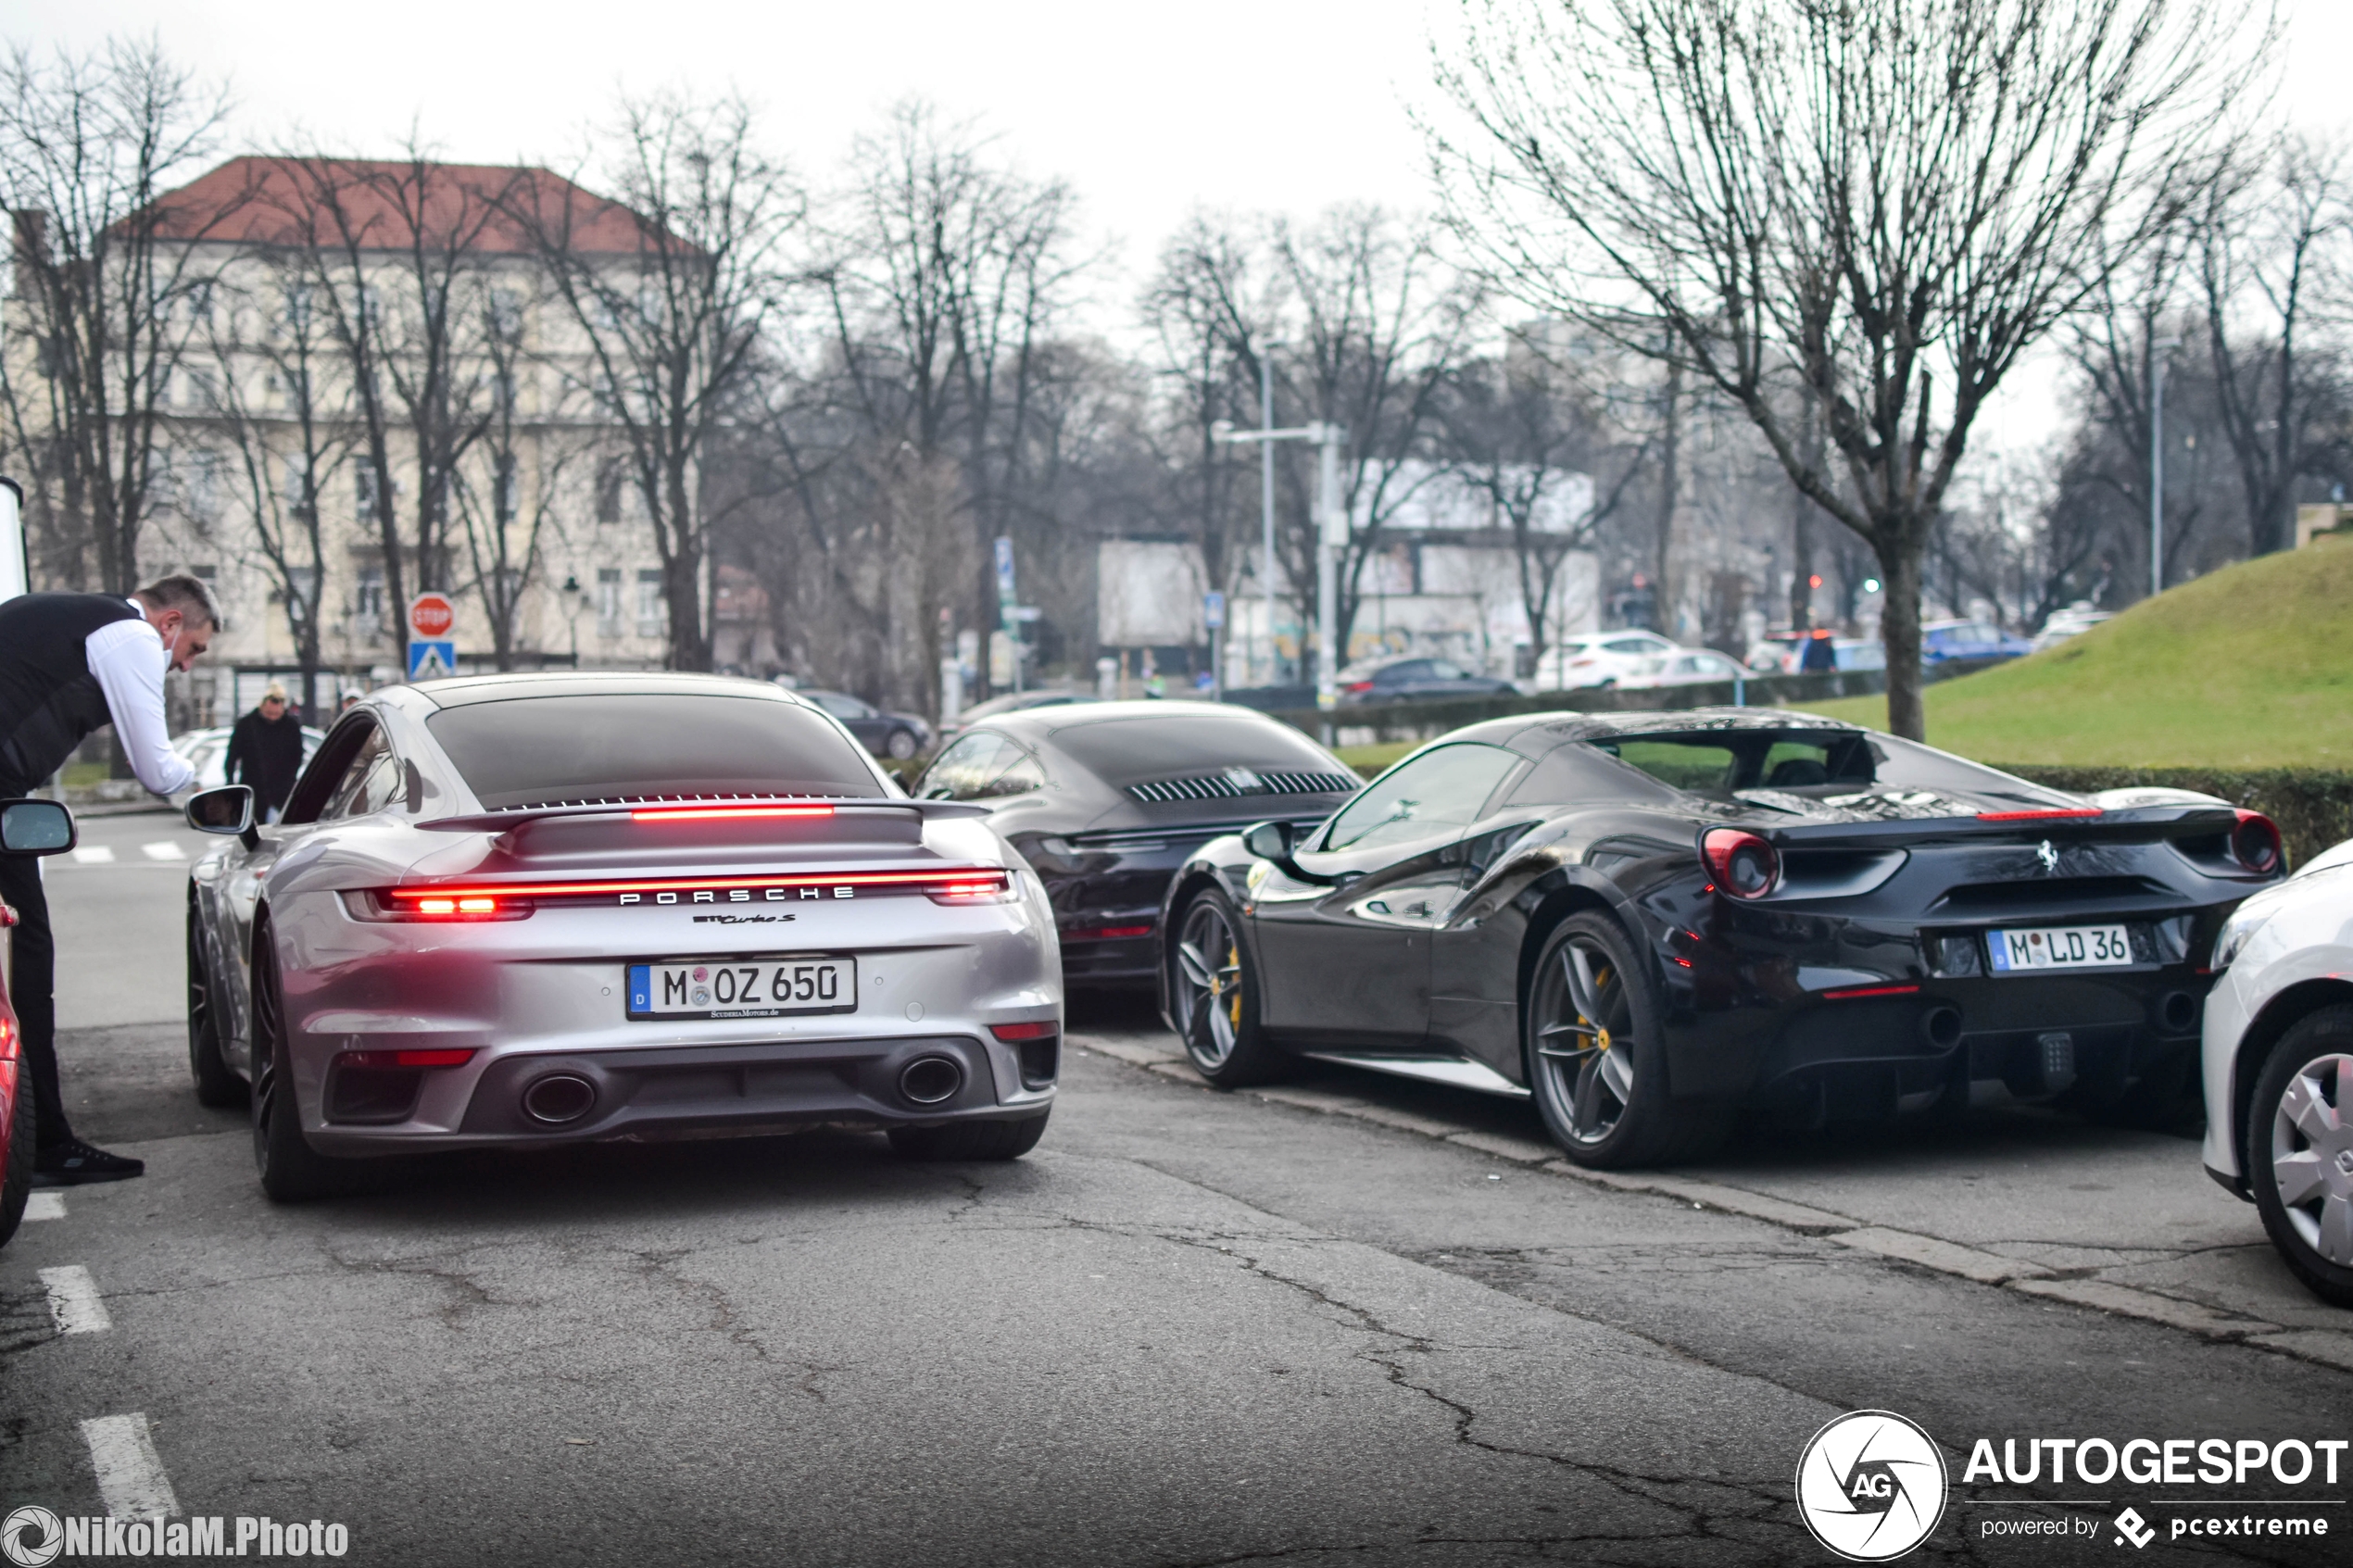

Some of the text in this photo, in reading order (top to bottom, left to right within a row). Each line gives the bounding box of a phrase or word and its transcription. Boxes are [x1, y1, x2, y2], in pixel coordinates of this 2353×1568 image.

[413, 608, 449, 626] STOP
[620, 886, 854, 906] PORSCHE
[2009, 930, 2126, 965] M LD 36
[663, 965, 837, 1006] M OZ 650
